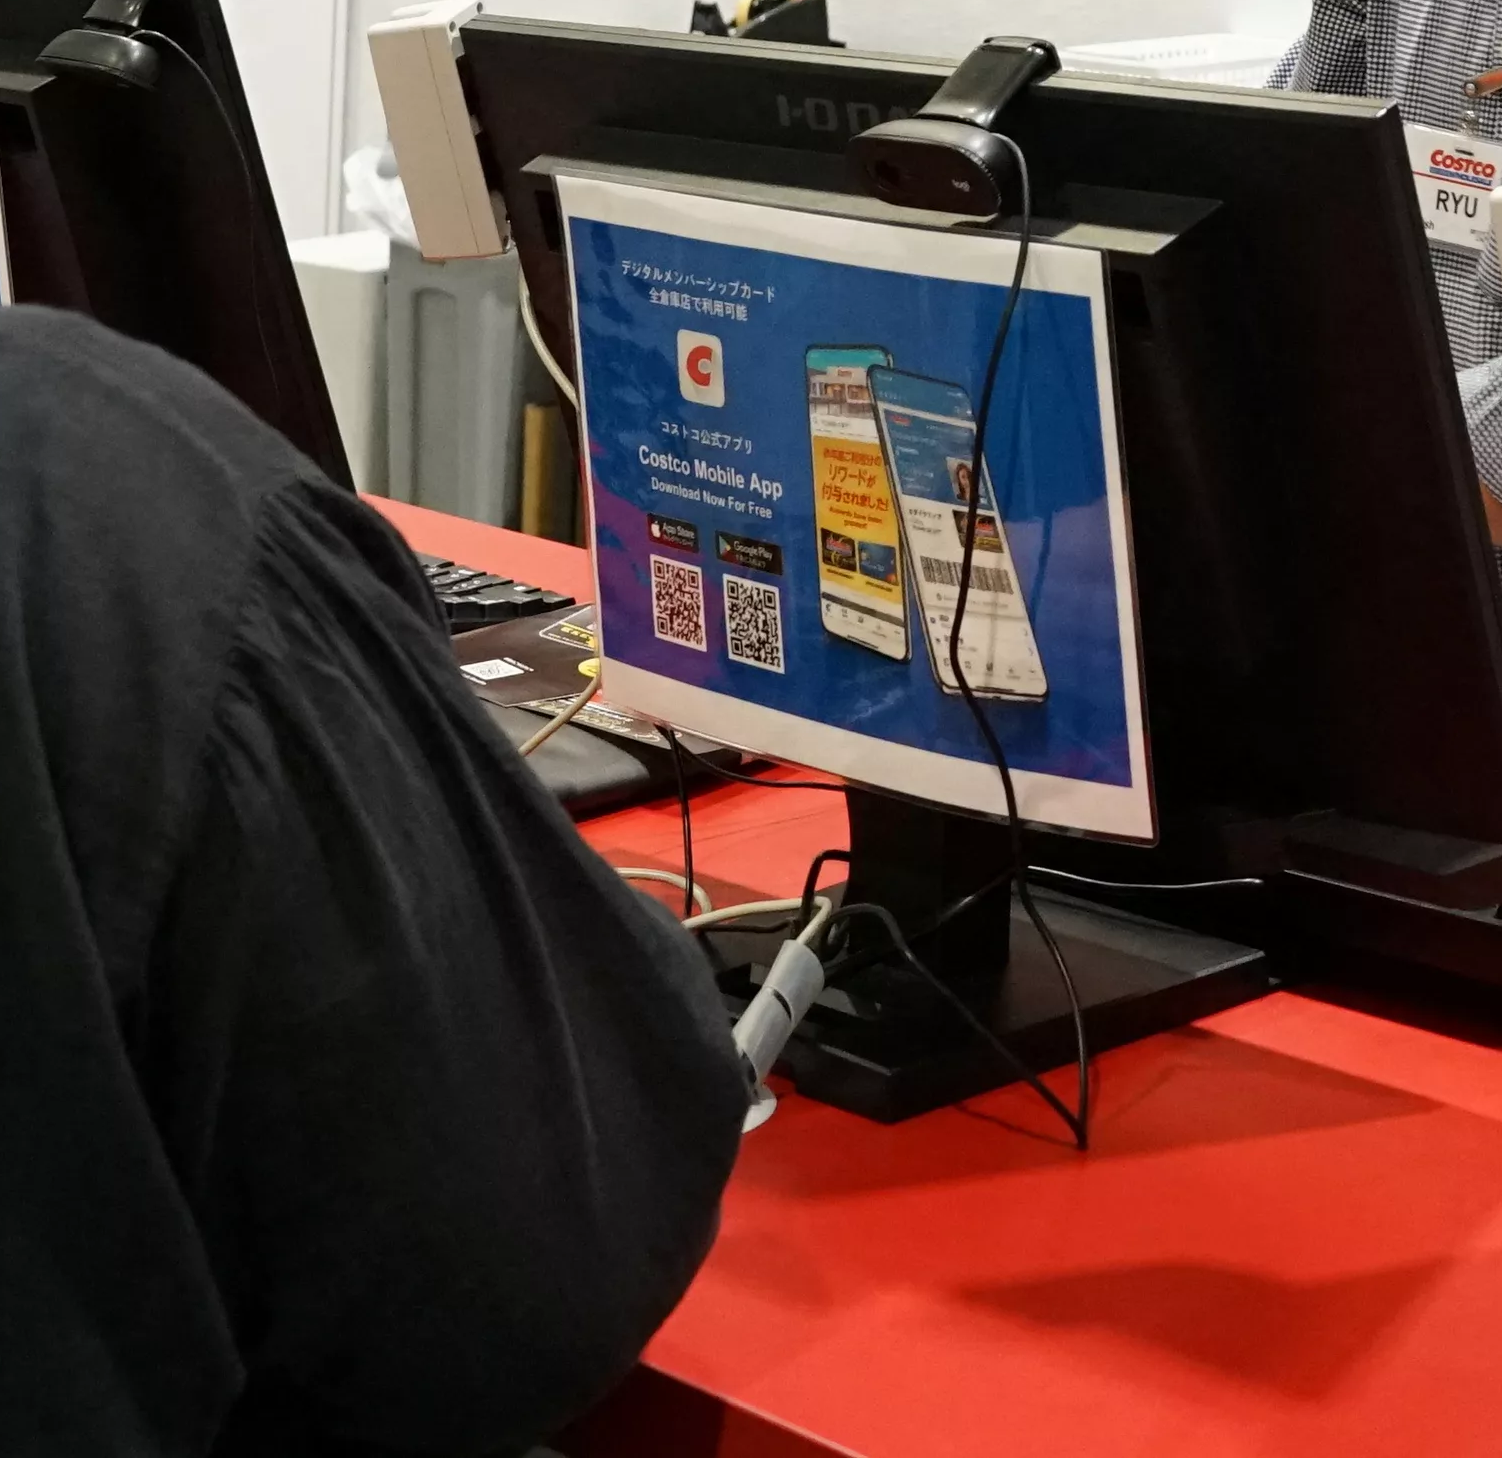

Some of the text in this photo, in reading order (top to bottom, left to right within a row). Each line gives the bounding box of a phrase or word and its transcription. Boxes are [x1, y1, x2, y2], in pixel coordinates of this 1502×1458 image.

[1430, 149, 1496, 178] COSTCO
[1435, 188, 1479, 219] RYU
[621, 259, 776, 304] デジタルメンバーシップカード
[648, 286, 749, 322] 全倉庫店で利用可能
[660, 421, 753, 455] コストコ公式アプリ
[638, 444, 784, 501] Costco Mobile App
[829, 463, 877, 489] リワードが
[650, 476, 773, 519] Download Now For Free
[662, 522, 676, 536] App
[733, 540, 758, 557] Google
